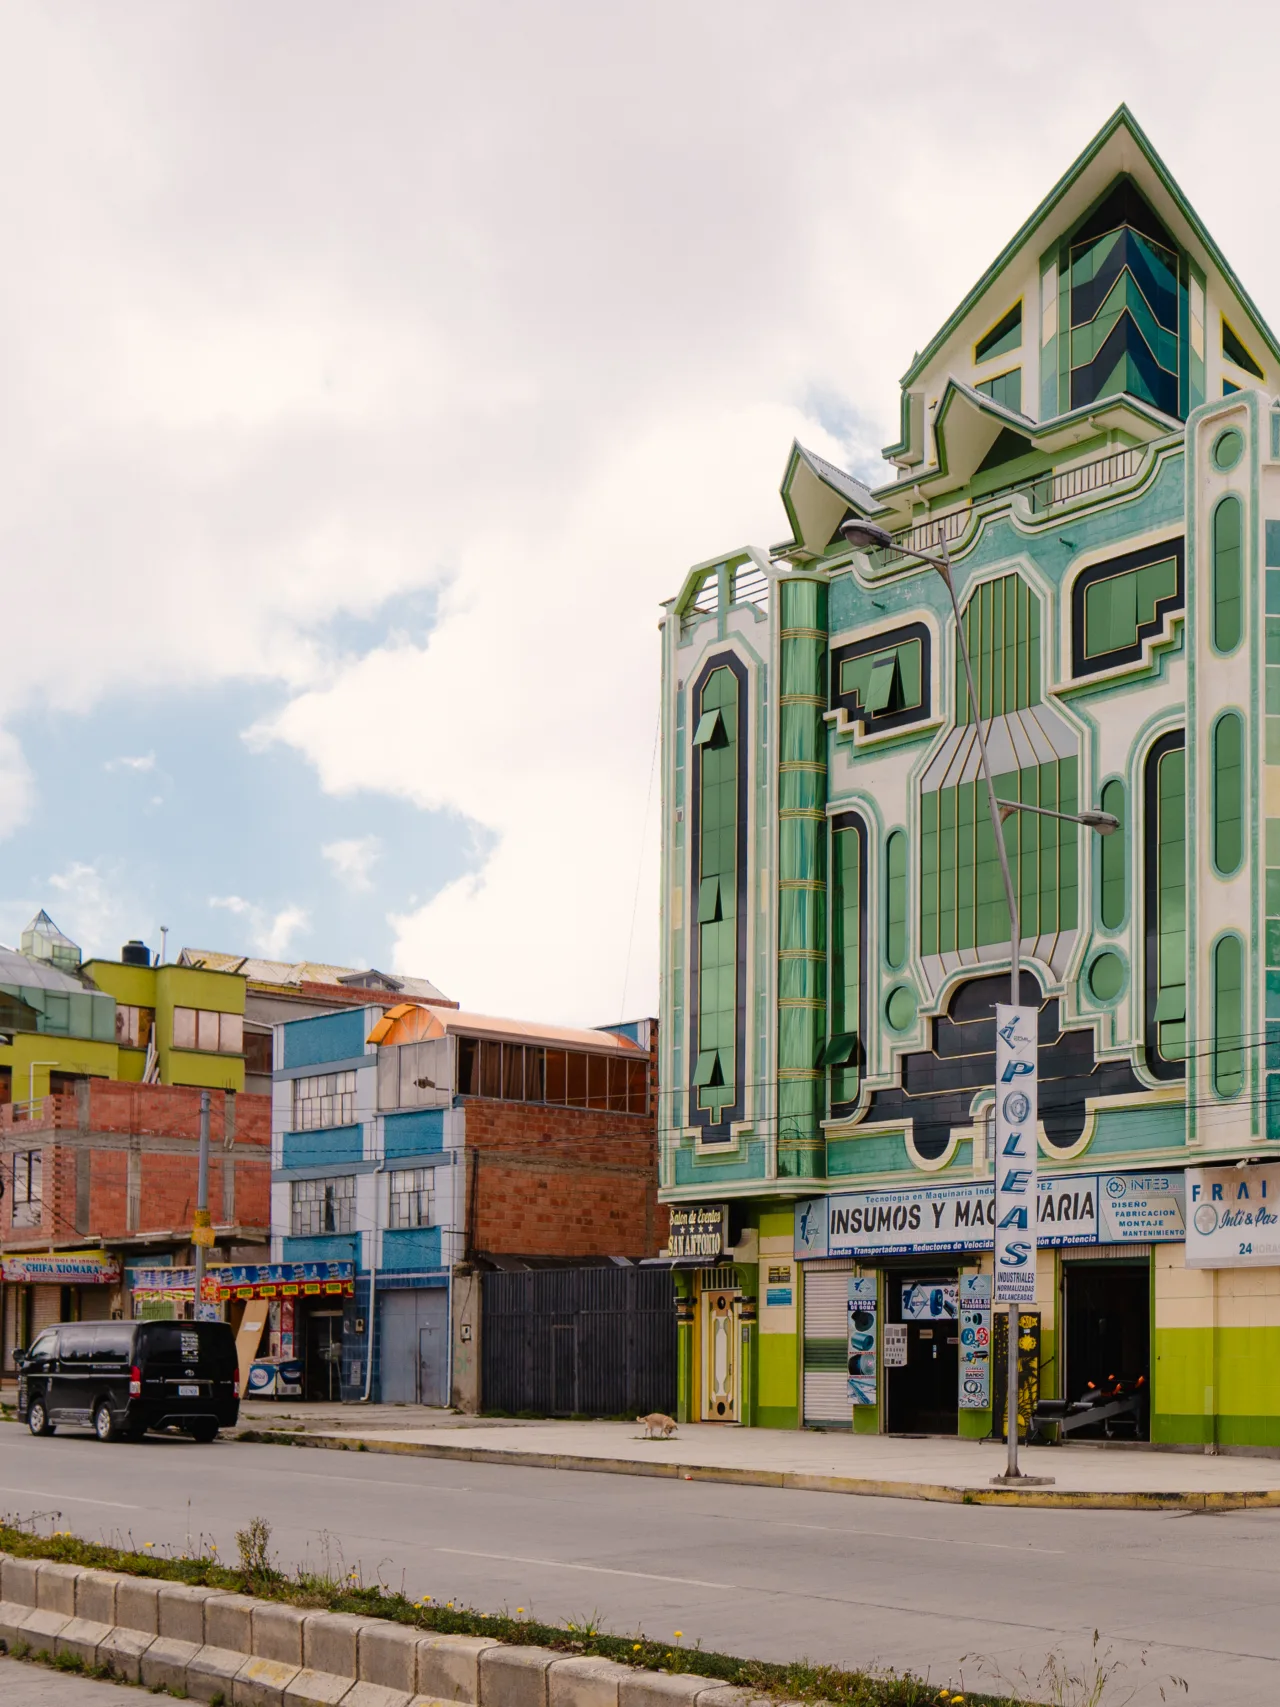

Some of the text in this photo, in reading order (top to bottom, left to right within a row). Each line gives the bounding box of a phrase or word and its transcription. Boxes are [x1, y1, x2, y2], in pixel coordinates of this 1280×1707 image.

[926, 1189, 973, 1200] Maquinaria
[1111, 1200, 1148, 1209] DISEÑO
[670, 1208, 721, 1225] Salon de Eventos
[830, 1204, 921, 1235] INSUMOS
[932, 1201, 946, 1229] Y
[1115, 1210, 1176, 1218] FABRICACION
[1219, 1206, 1279, 1229] Inti & Paz
[1122, 1229, 1185, 1237] MANTENIMIENTO
[668, 1232, 721, 1257] SAN ANTONIO
[829, 1248, 852, 1256] Bandas
[854, 1245, 907, 1255] Transportadoras
[913, 1243, 951, 1252] Reductores
[964, 1240, 994, 1249] Velocida
[1051, 1235, 1061, 1244] de
[1062, 1234, 1097, 1244] Potencia
[997, 1272, 1035, 1284] INDUSTRIALES
[997, 1285, 1035, 1293] NORMALIZADAS
[998, 1293, 1033, 1301] BALANCEADAS
